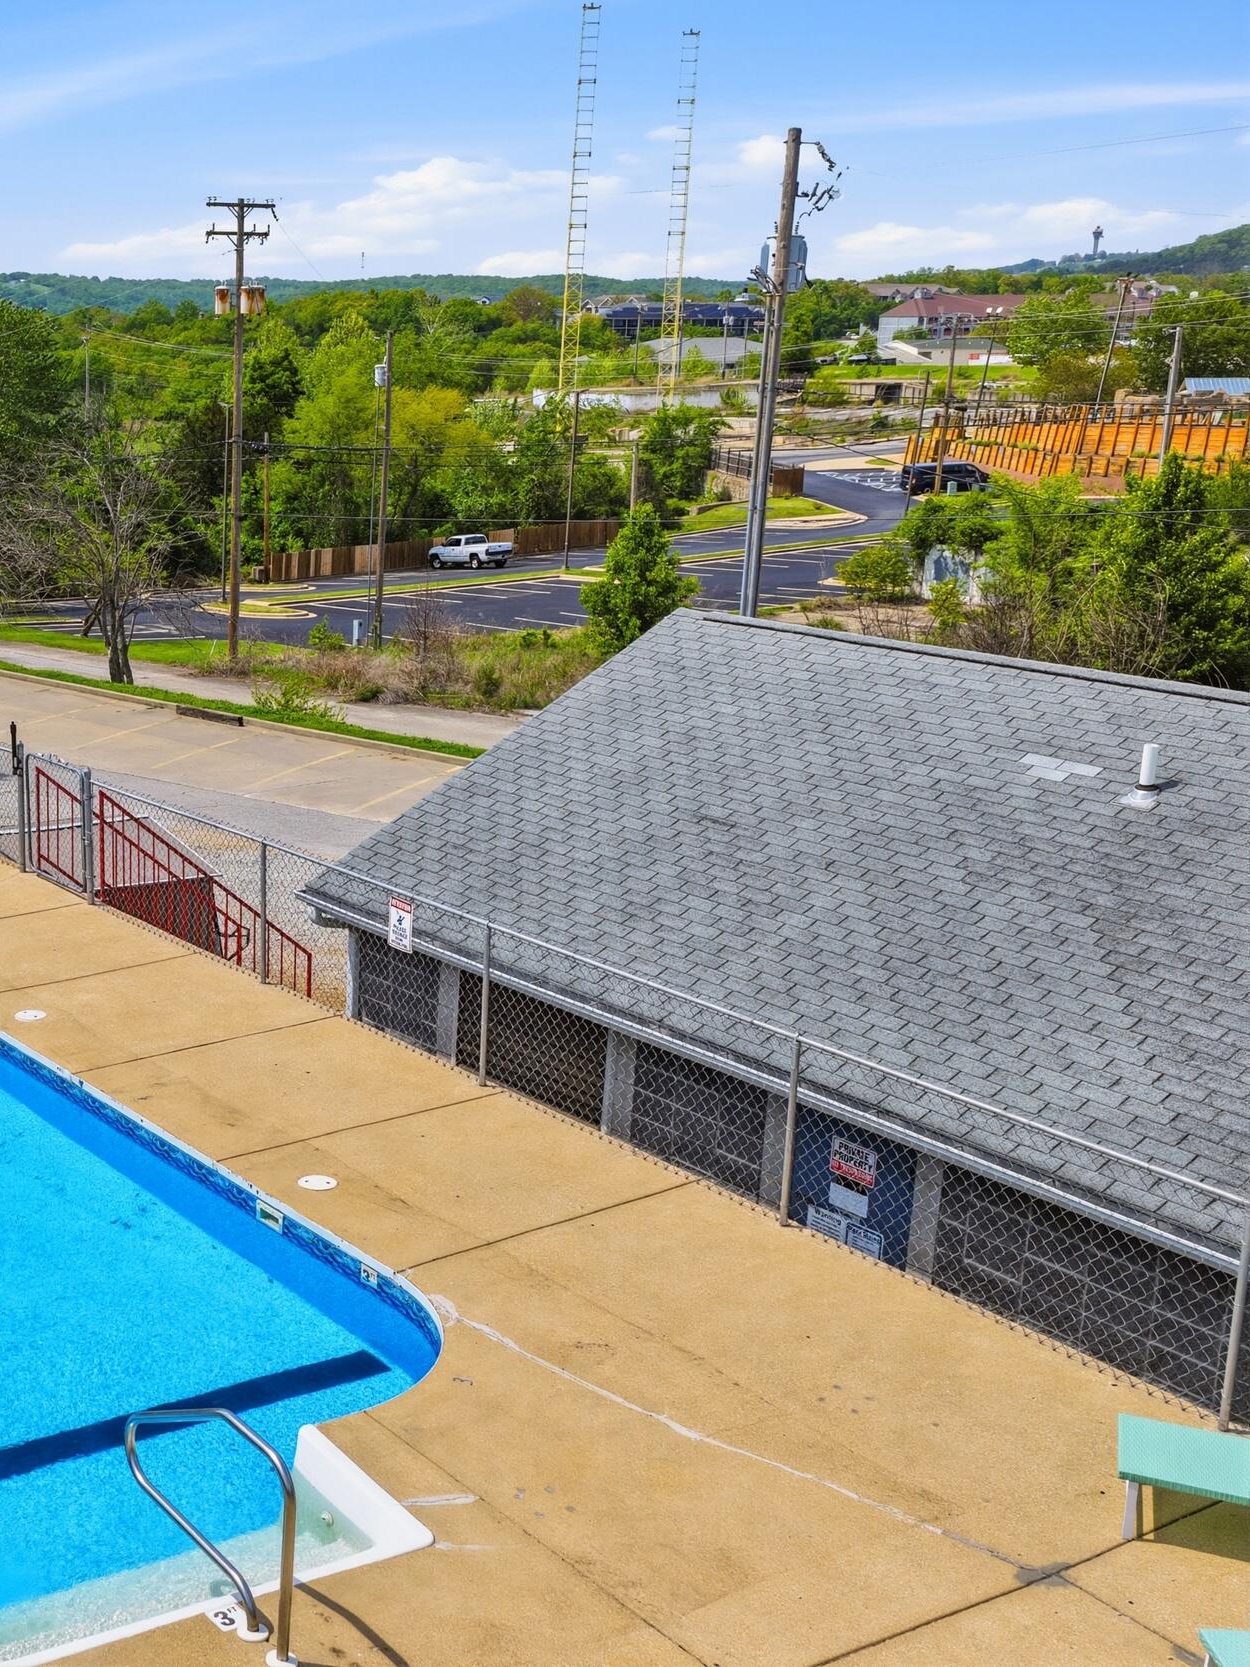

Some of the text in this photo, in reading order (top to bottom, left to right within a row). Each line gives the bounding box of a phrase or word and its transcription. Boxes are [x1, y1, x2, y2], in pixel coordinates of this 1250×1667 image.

[833, 1149, 873, 1173] PROPERTY
[838, 1141, 870, 1162] PRIVATE
[362, 1269, 370, 1282] 3
[213, 1606, 237, 1626] 3 FT
